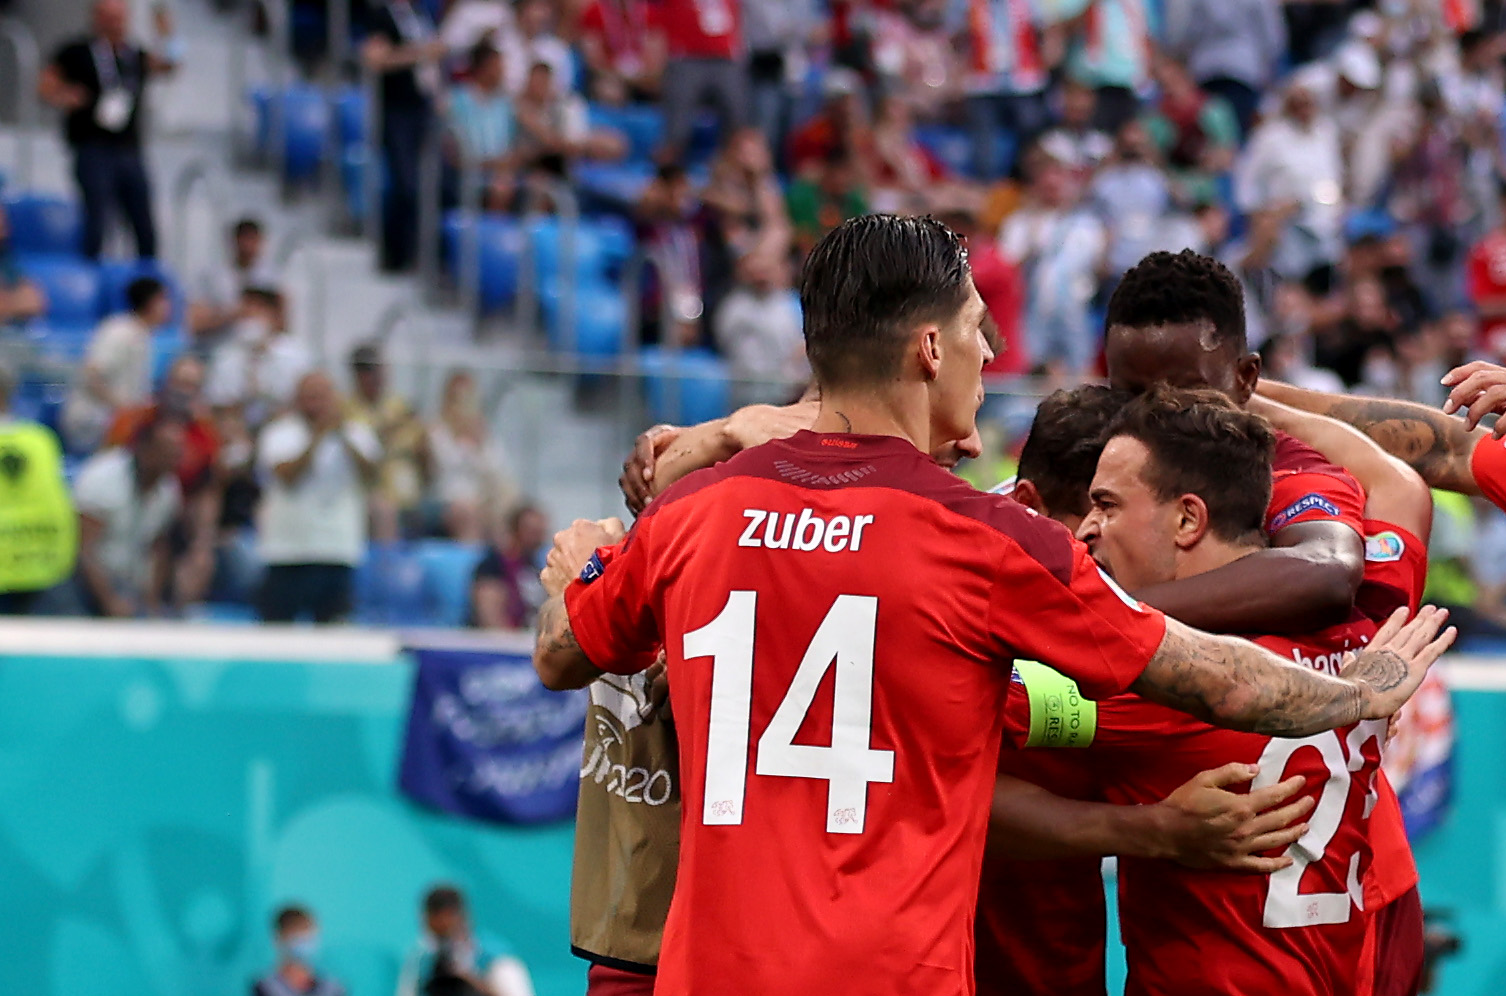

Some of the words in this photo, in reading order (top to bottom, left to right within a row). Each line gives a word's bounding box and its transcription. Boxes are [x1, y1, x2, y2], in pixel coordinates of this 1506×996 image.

[1286, 496, 1340, 517] RESPECT
[738, 508, 873, 552] zuber
[683, 590, 895, 834] 14
[1070, 710, 1080, 730] TO
